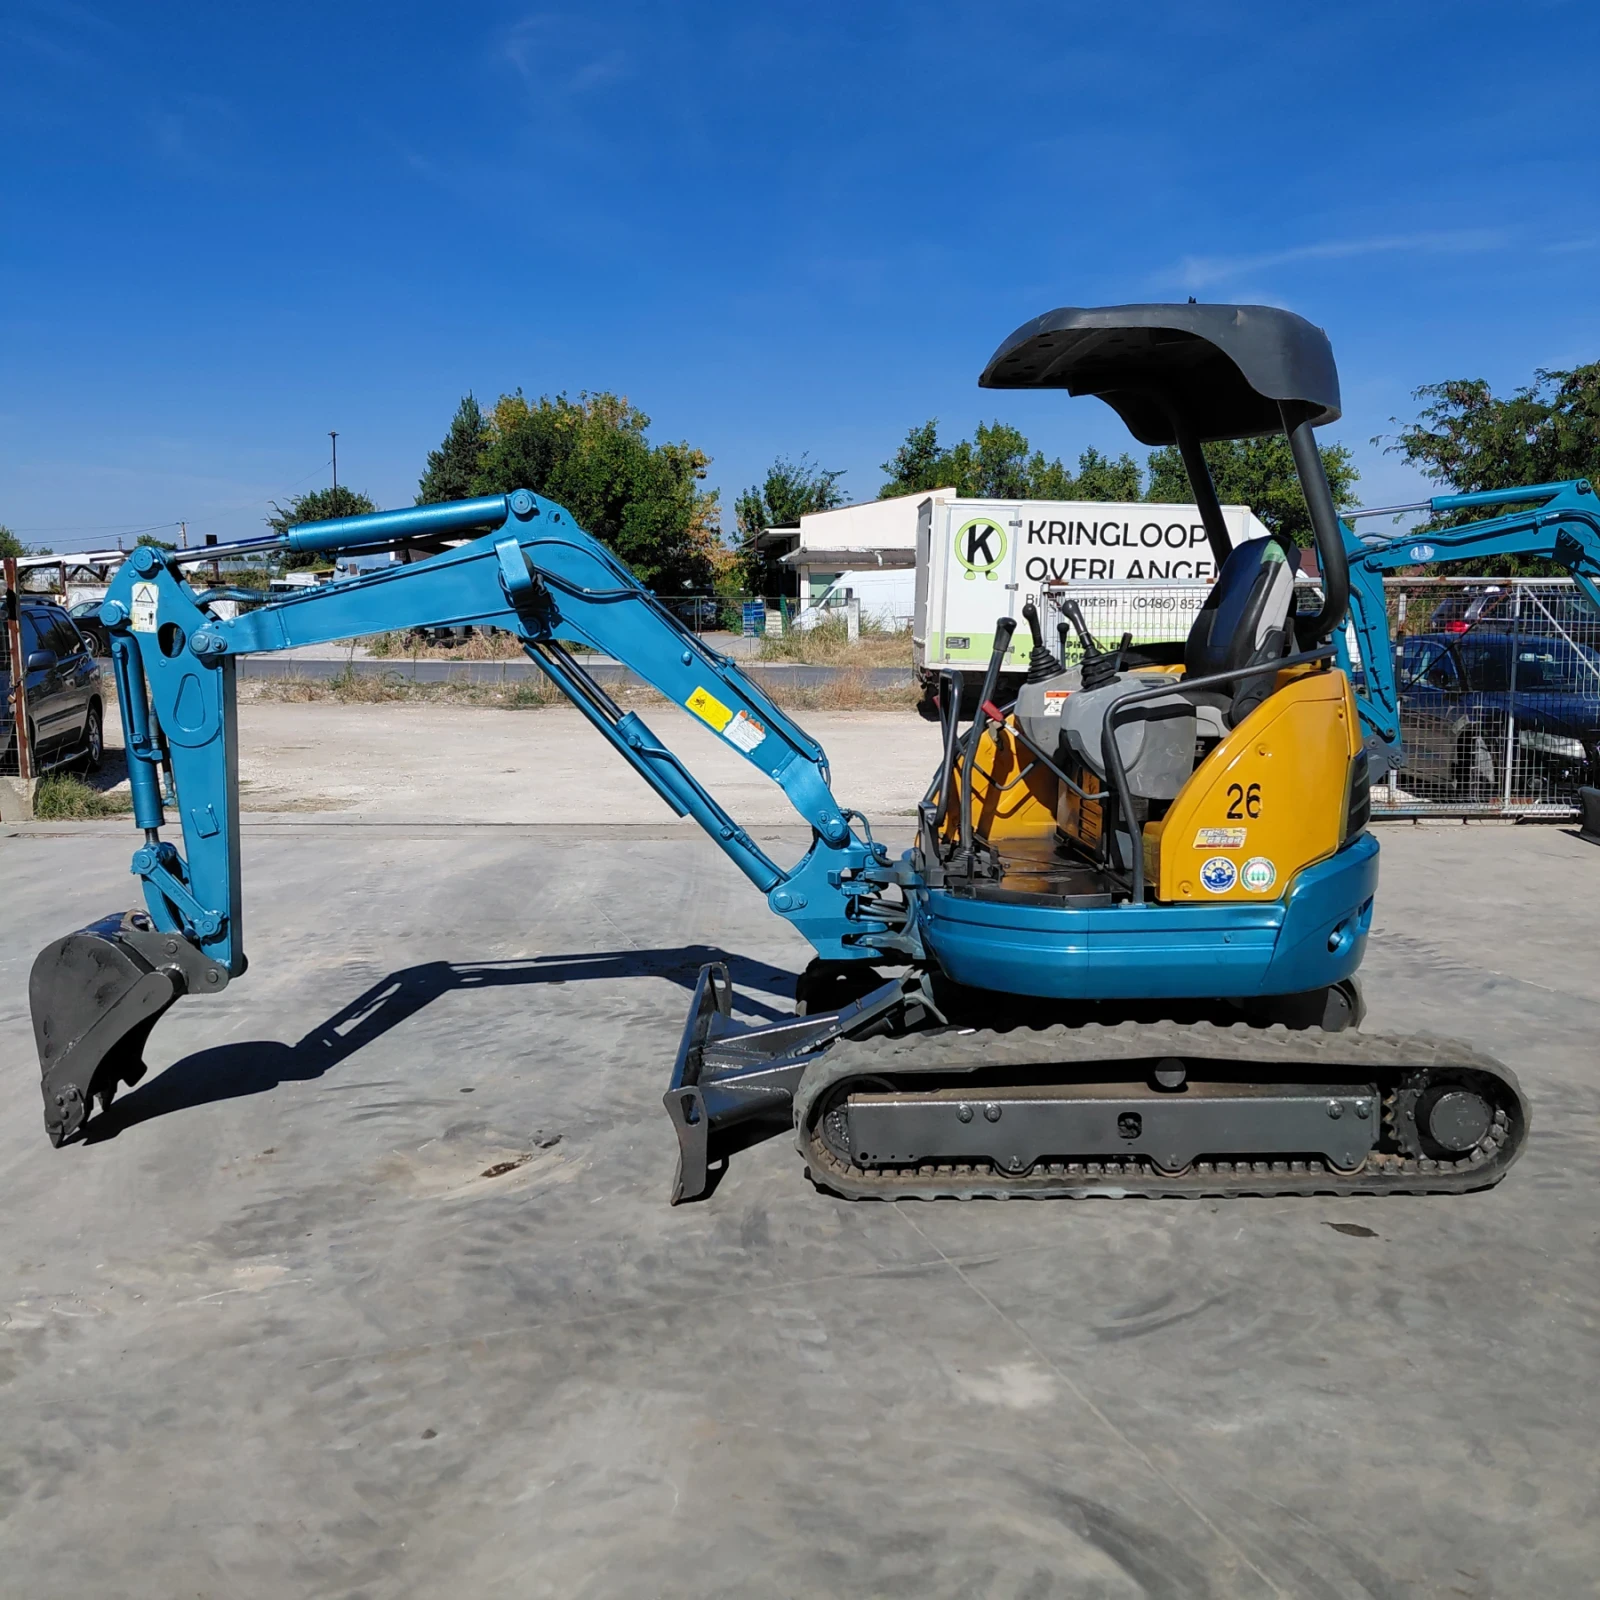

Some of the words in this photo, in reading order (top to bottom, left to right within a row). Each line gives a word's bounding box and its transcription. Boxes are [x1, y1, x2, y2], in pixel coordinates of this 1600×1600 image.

[967, 524, 995, 572] K
[1027, 520, 1208, 549] KRINGLOOP
[1025, 556, 1220, 581] OVERLANGE
[1132, 596, 1176, 611] (0486)
[1180, 599, 1207, 610] 852
[1226, 783, 1262, 819] 26
